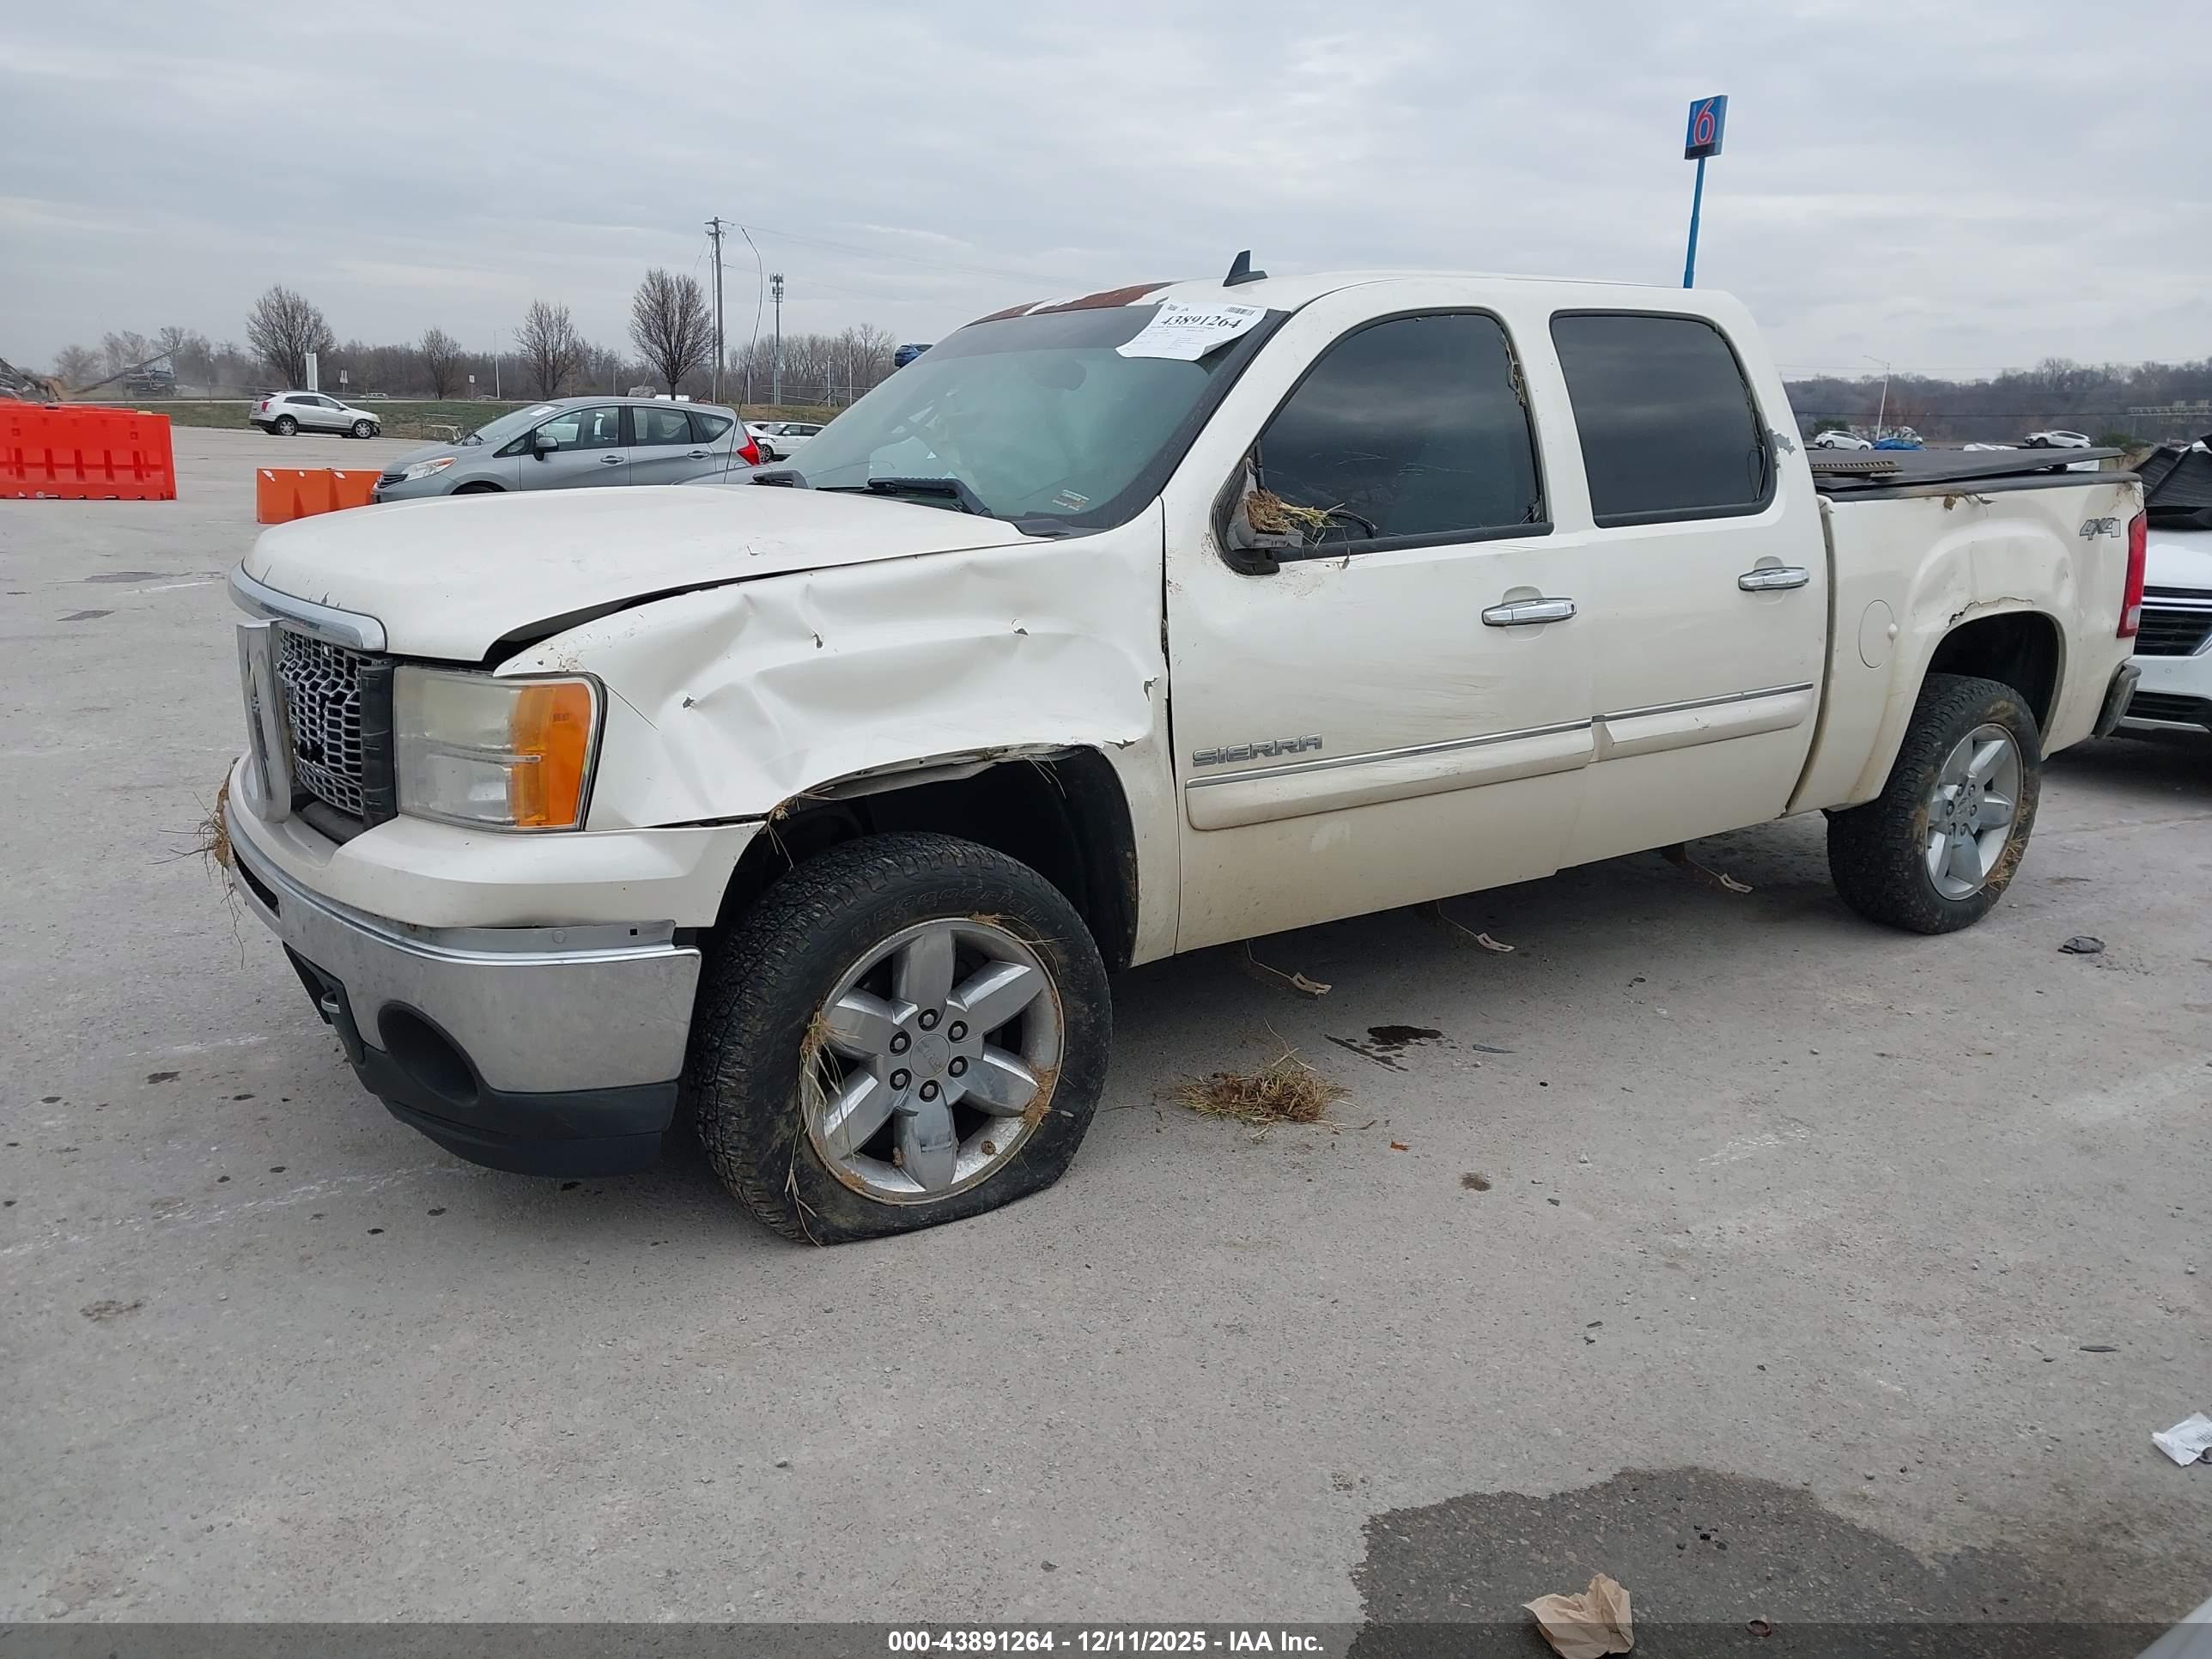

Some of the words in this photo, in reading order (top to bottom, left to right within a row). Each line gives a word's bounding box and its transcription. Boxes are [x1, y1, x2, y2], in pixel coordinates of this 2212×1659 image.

[1694, 98, 1715, 145] 6
[1160, 314, 1243, 329] 43891264
[1193, 732, 1323, 767] SIERRA
